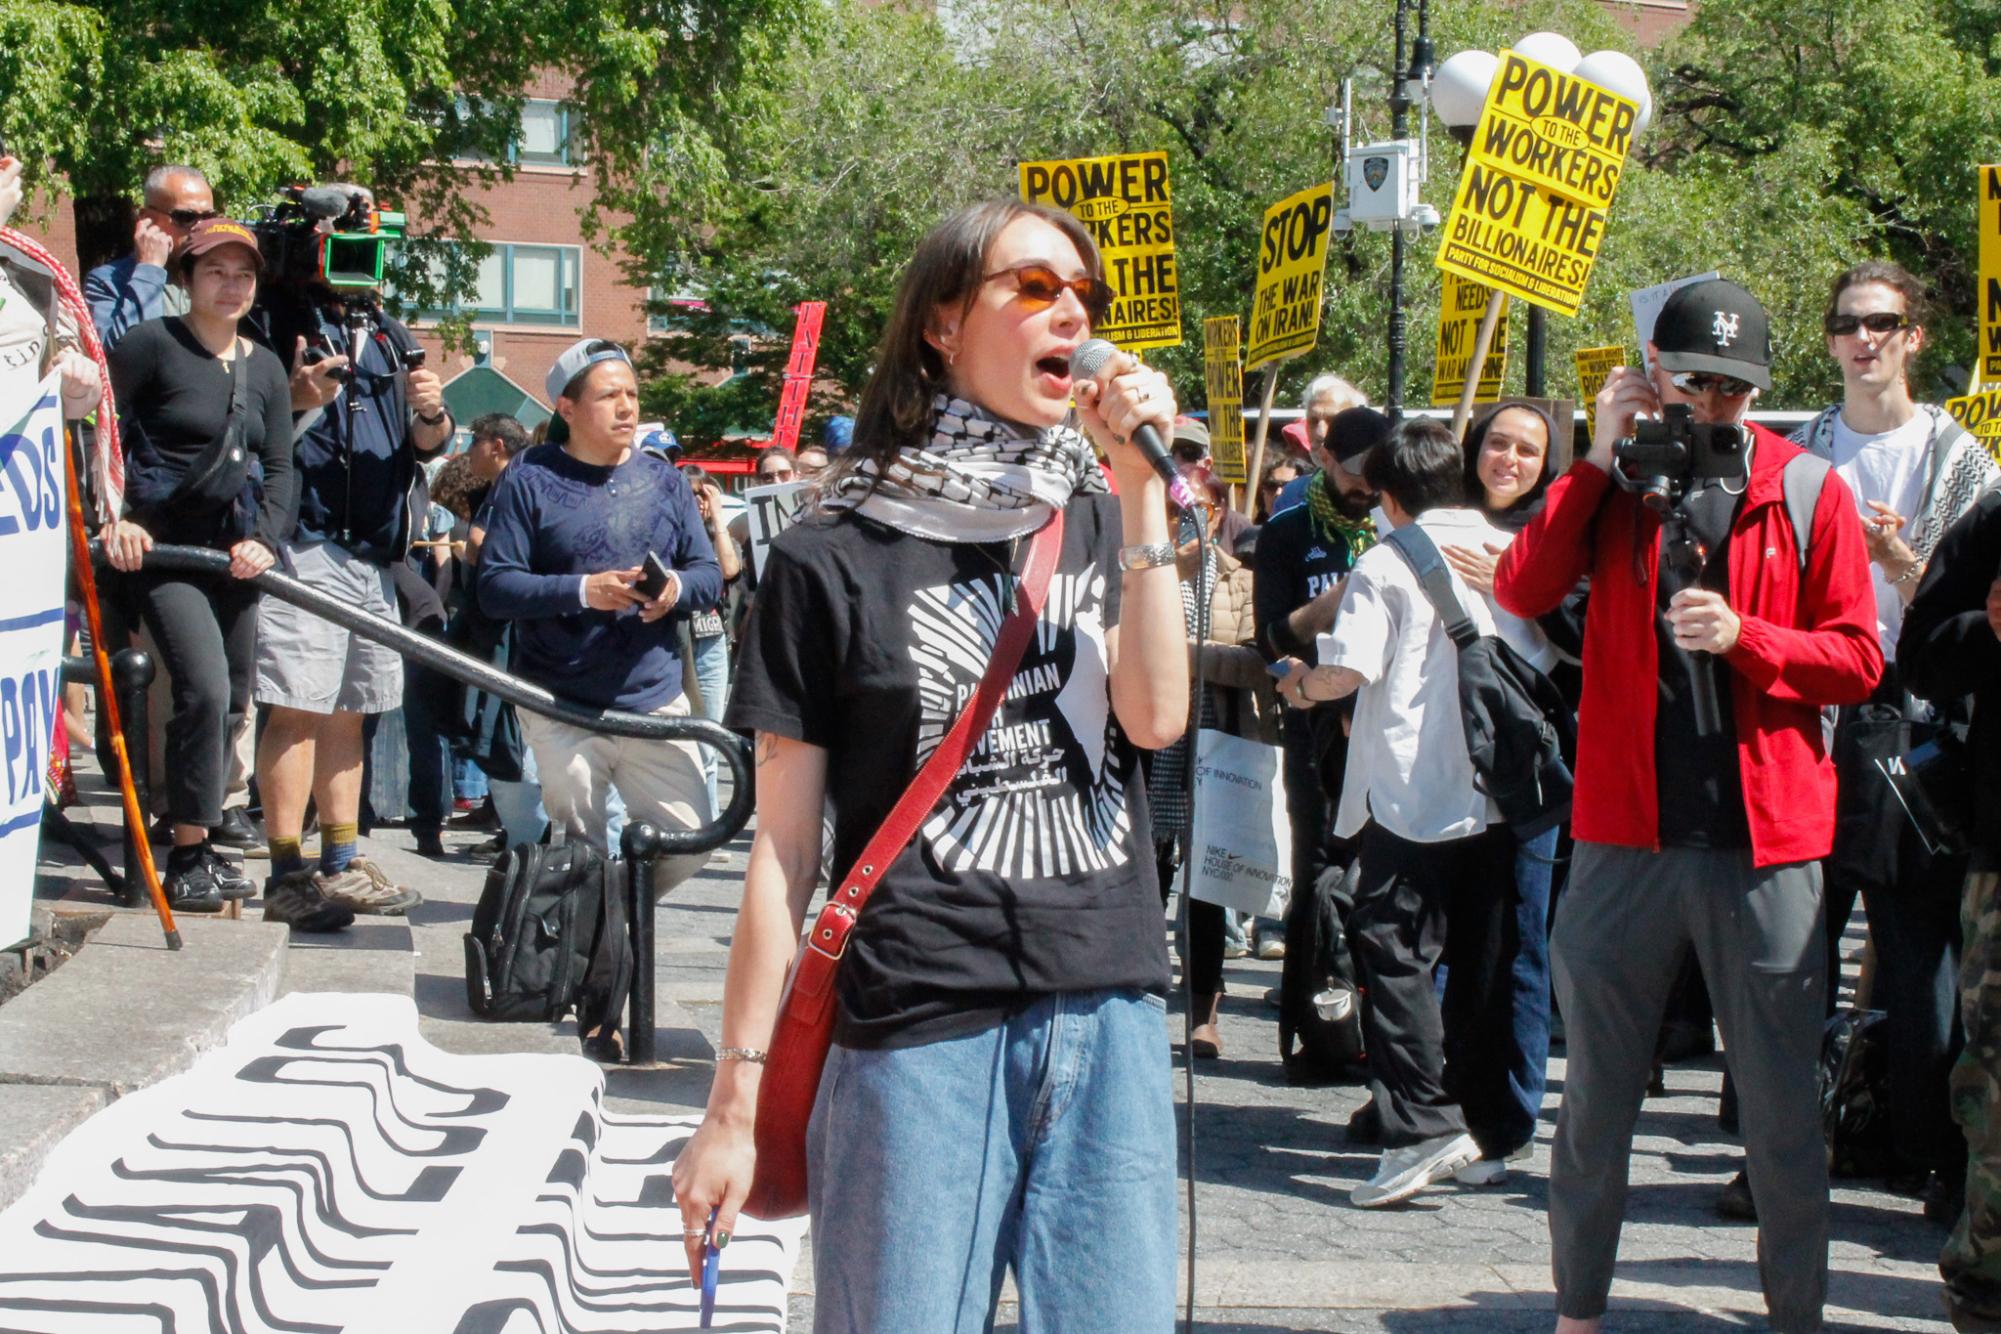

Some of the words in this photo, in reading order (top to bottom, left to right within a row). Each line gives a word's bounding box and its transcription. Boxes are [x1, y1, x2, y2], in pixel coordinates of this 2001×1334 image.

[1495, 56, 1636, 155] POWER
[1542, 120, 1557, 138] TO
[1560, 124, 1581, 145] THE
[1483, 115, 1619, 200] WORKERS
[1027, 158, 1168, 208] POWER
[1078, 203, 1094, 218] TO
[1098, 200, 1119, 216] THE
[1462, 166, 1536, 229] NOT
[1540, 194, 1604, 258] THE
[1261, 195, 1332, 274] STOP
[1452, 214, 1590, 288] BILLIONAIRES!
[1113, 254, 1176, 297] THE
[1258, 281, 1279, 316] THE
[1283, 270, 1320, 304] WAR
[1448, 247, 1473, 266] PARTY
[1472, 256, 1490, 272] FOR
[1488, 262, 1530, 286] SOCIALISM
[1534, 280, 1580, 306] LIBERATION
[1133, 325, 1178, 340] LIBERATION
[1255, 315, 1271, 344] ON
[1274, 300, 1314, 338] IRAN!
[1440, 318, 1467, 356] NOT
[1213, 768, 1262, 791] INNOVATION
[1204, 856, 1233, 871] HOUSE
[1233, 862, 1245, 873] OF
[1245, 867, 1292, 888] INNOVATION
[1206, 845, 1227, 858] NIKE
